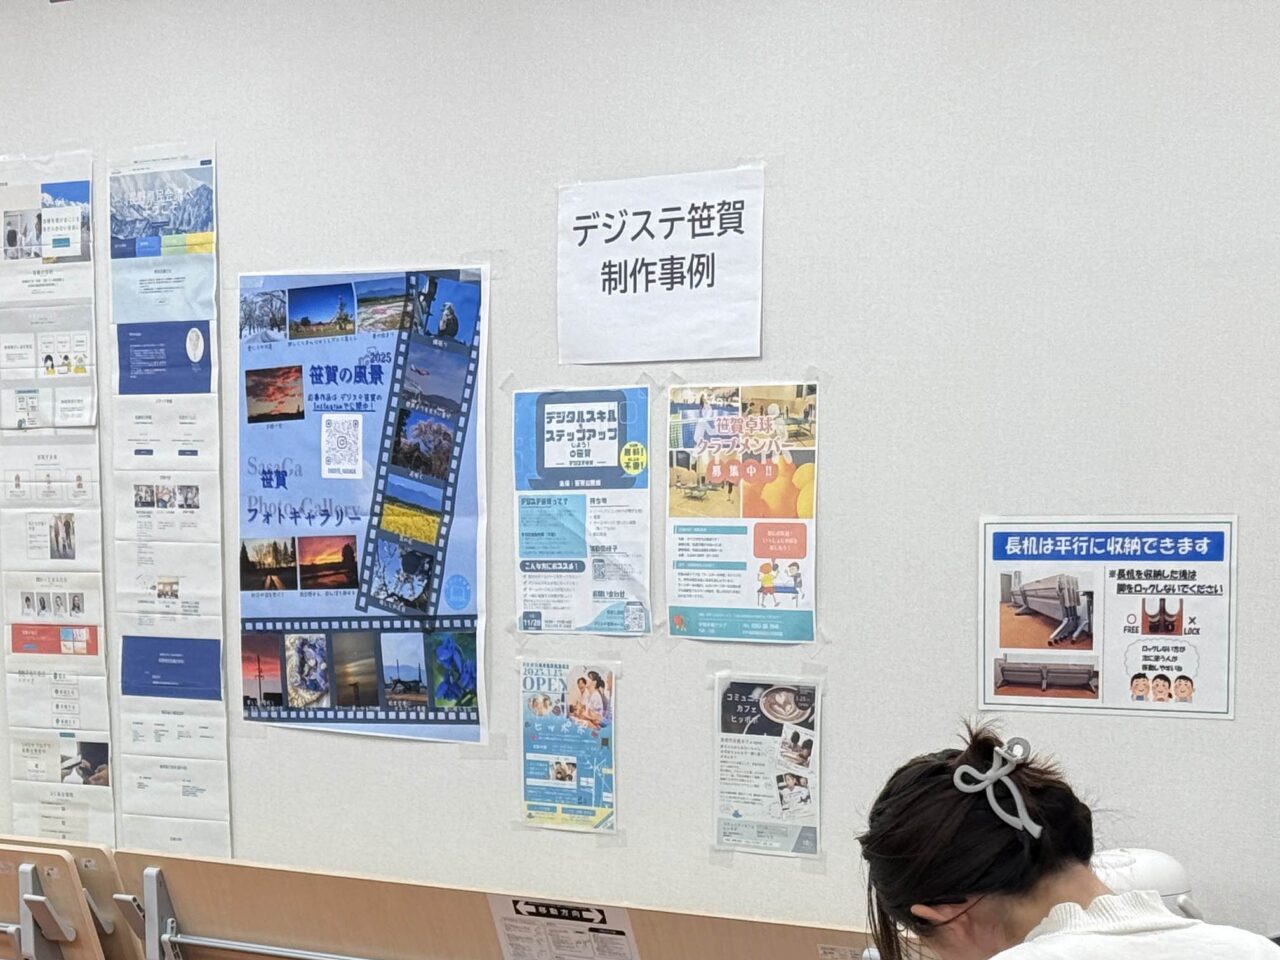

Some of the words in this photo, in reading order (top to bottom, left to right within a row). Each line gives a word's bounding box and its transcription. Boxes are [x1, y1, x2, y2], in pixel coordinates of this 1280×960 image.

[572, 199, 746, 248] デジステ笹賀
[599, 252, 716, 295] 制作事例
[370, 352, 392, 364] 2025
[309, 364, 384, 386] 笹賀の風景
[545, 409, 617, 424] デジタルスキル
[716, 416, 773, 434] 笹賀卓球
[545, 427, 618, 442] ステップアップ
[696, 438, 795, 455] クラブメンバー
[1004, 536, 1212, 555] 長机は平行に収納できます
[1123, 626, 1139, 634] FREE
[1183, 627, 1201, 635] LOCK
[538, 907, 581, 918] 移動方向
